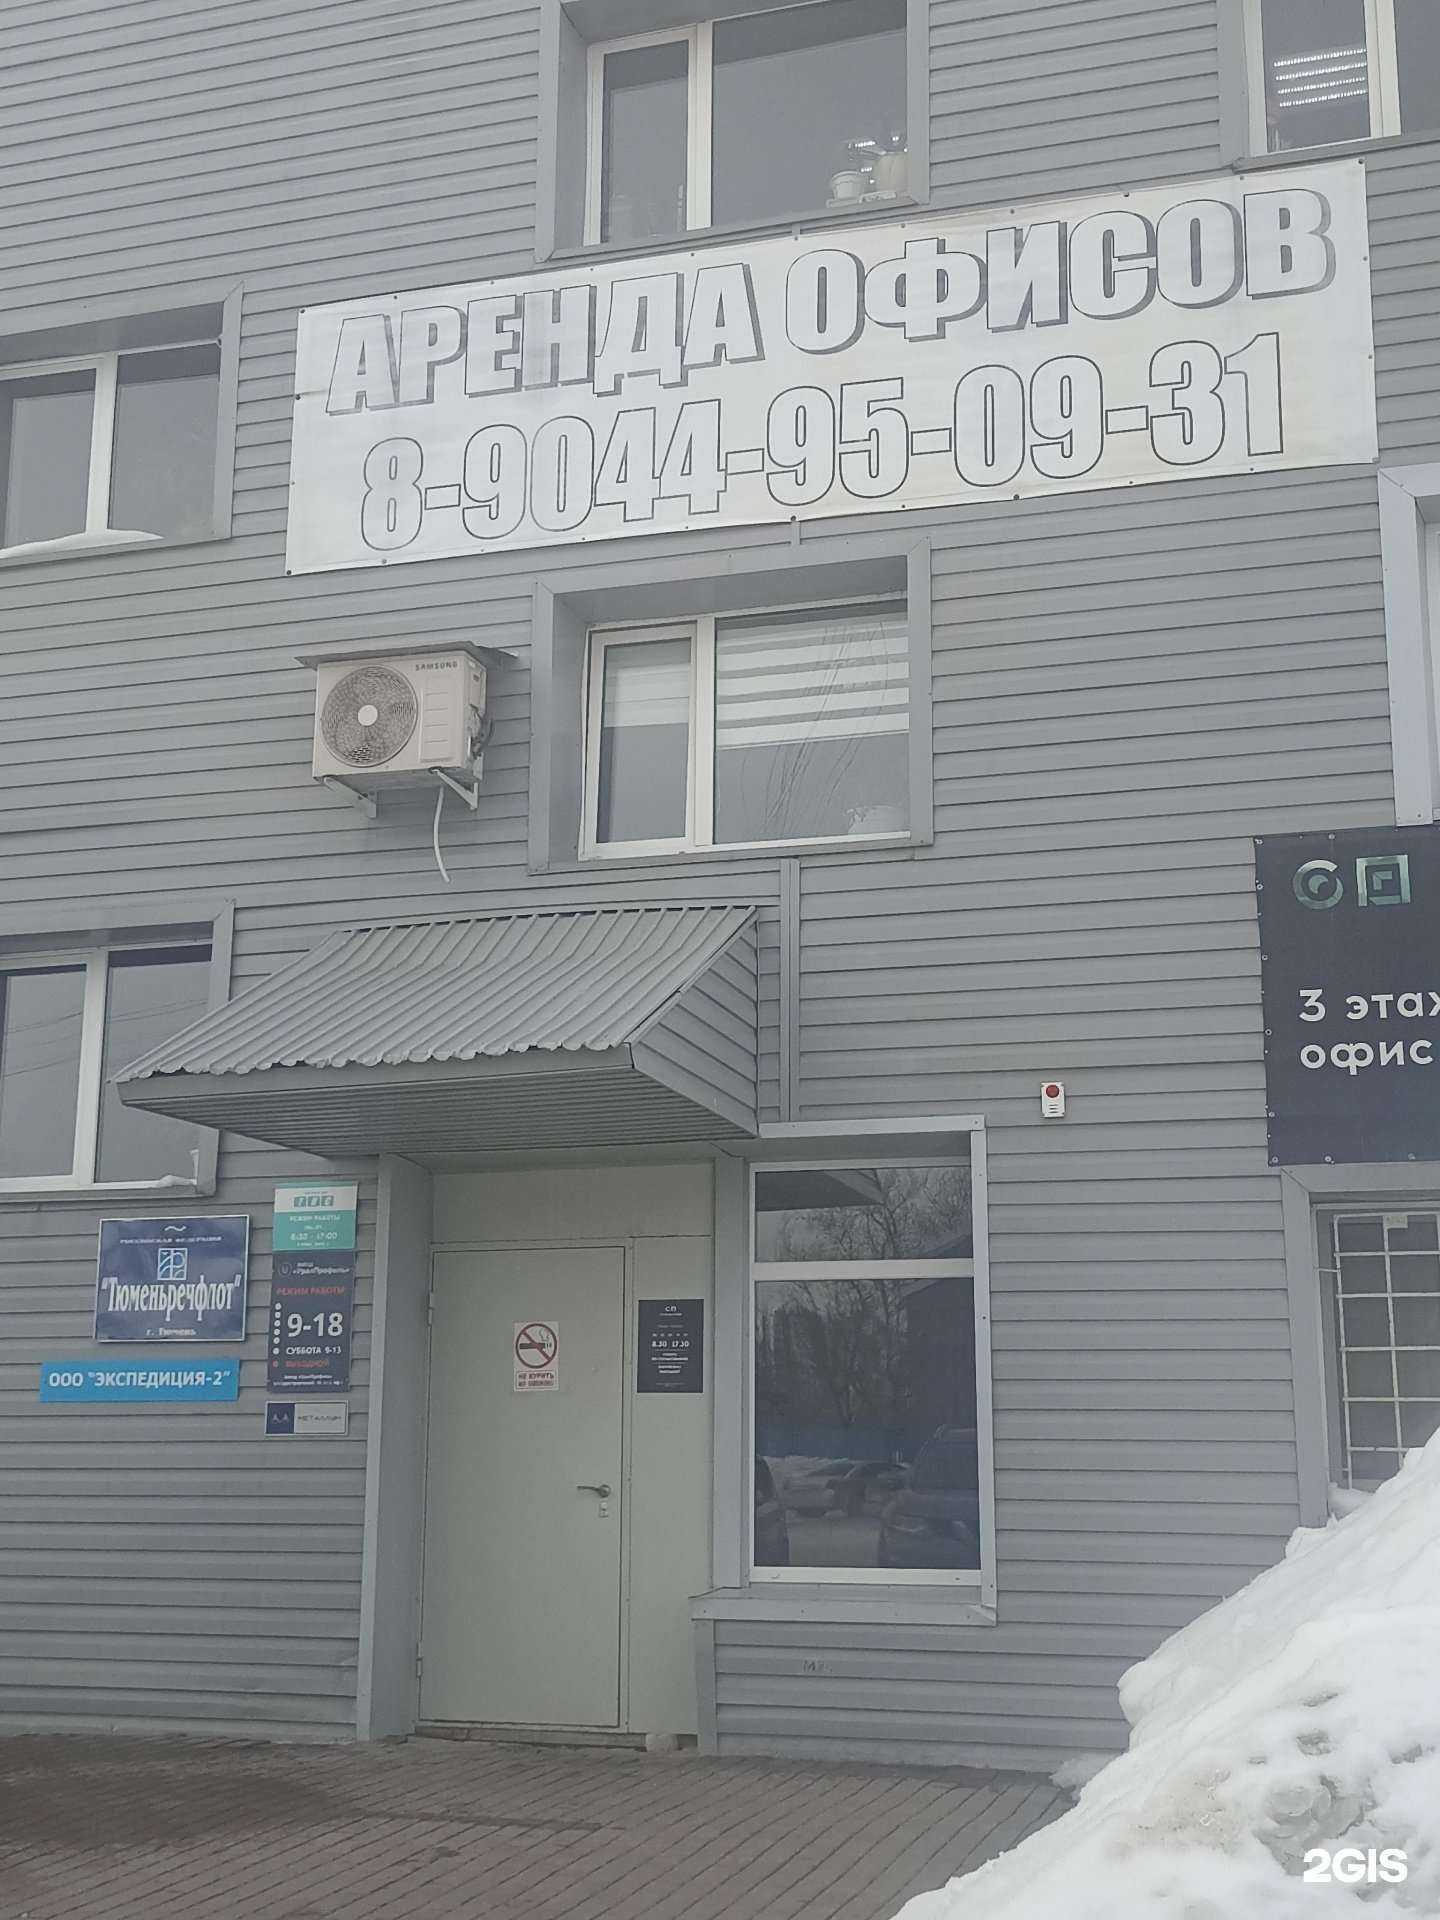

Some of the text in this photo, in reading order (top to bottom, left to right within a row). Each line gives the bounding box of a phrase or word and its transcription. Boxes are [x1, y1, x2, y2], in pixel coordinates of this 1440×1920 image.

[326, 188, 1335, 416] АРЕНДА ОФИСОВ
[361, 332, 1283, 551] 8-9044-95-09-31
[415, 661, 457, 671] SAMSUNG
[1299, 989, 1326, 1022] 3
[1301, 1039, 1434, 1076] офис
[287, 1312, 343, 1337] 9-18
[286, 1346, 322, 1355] СУББОТА
[49, 1370, 231, 1388] ООО "ЭКСПЕДИЦИЯ-2"
